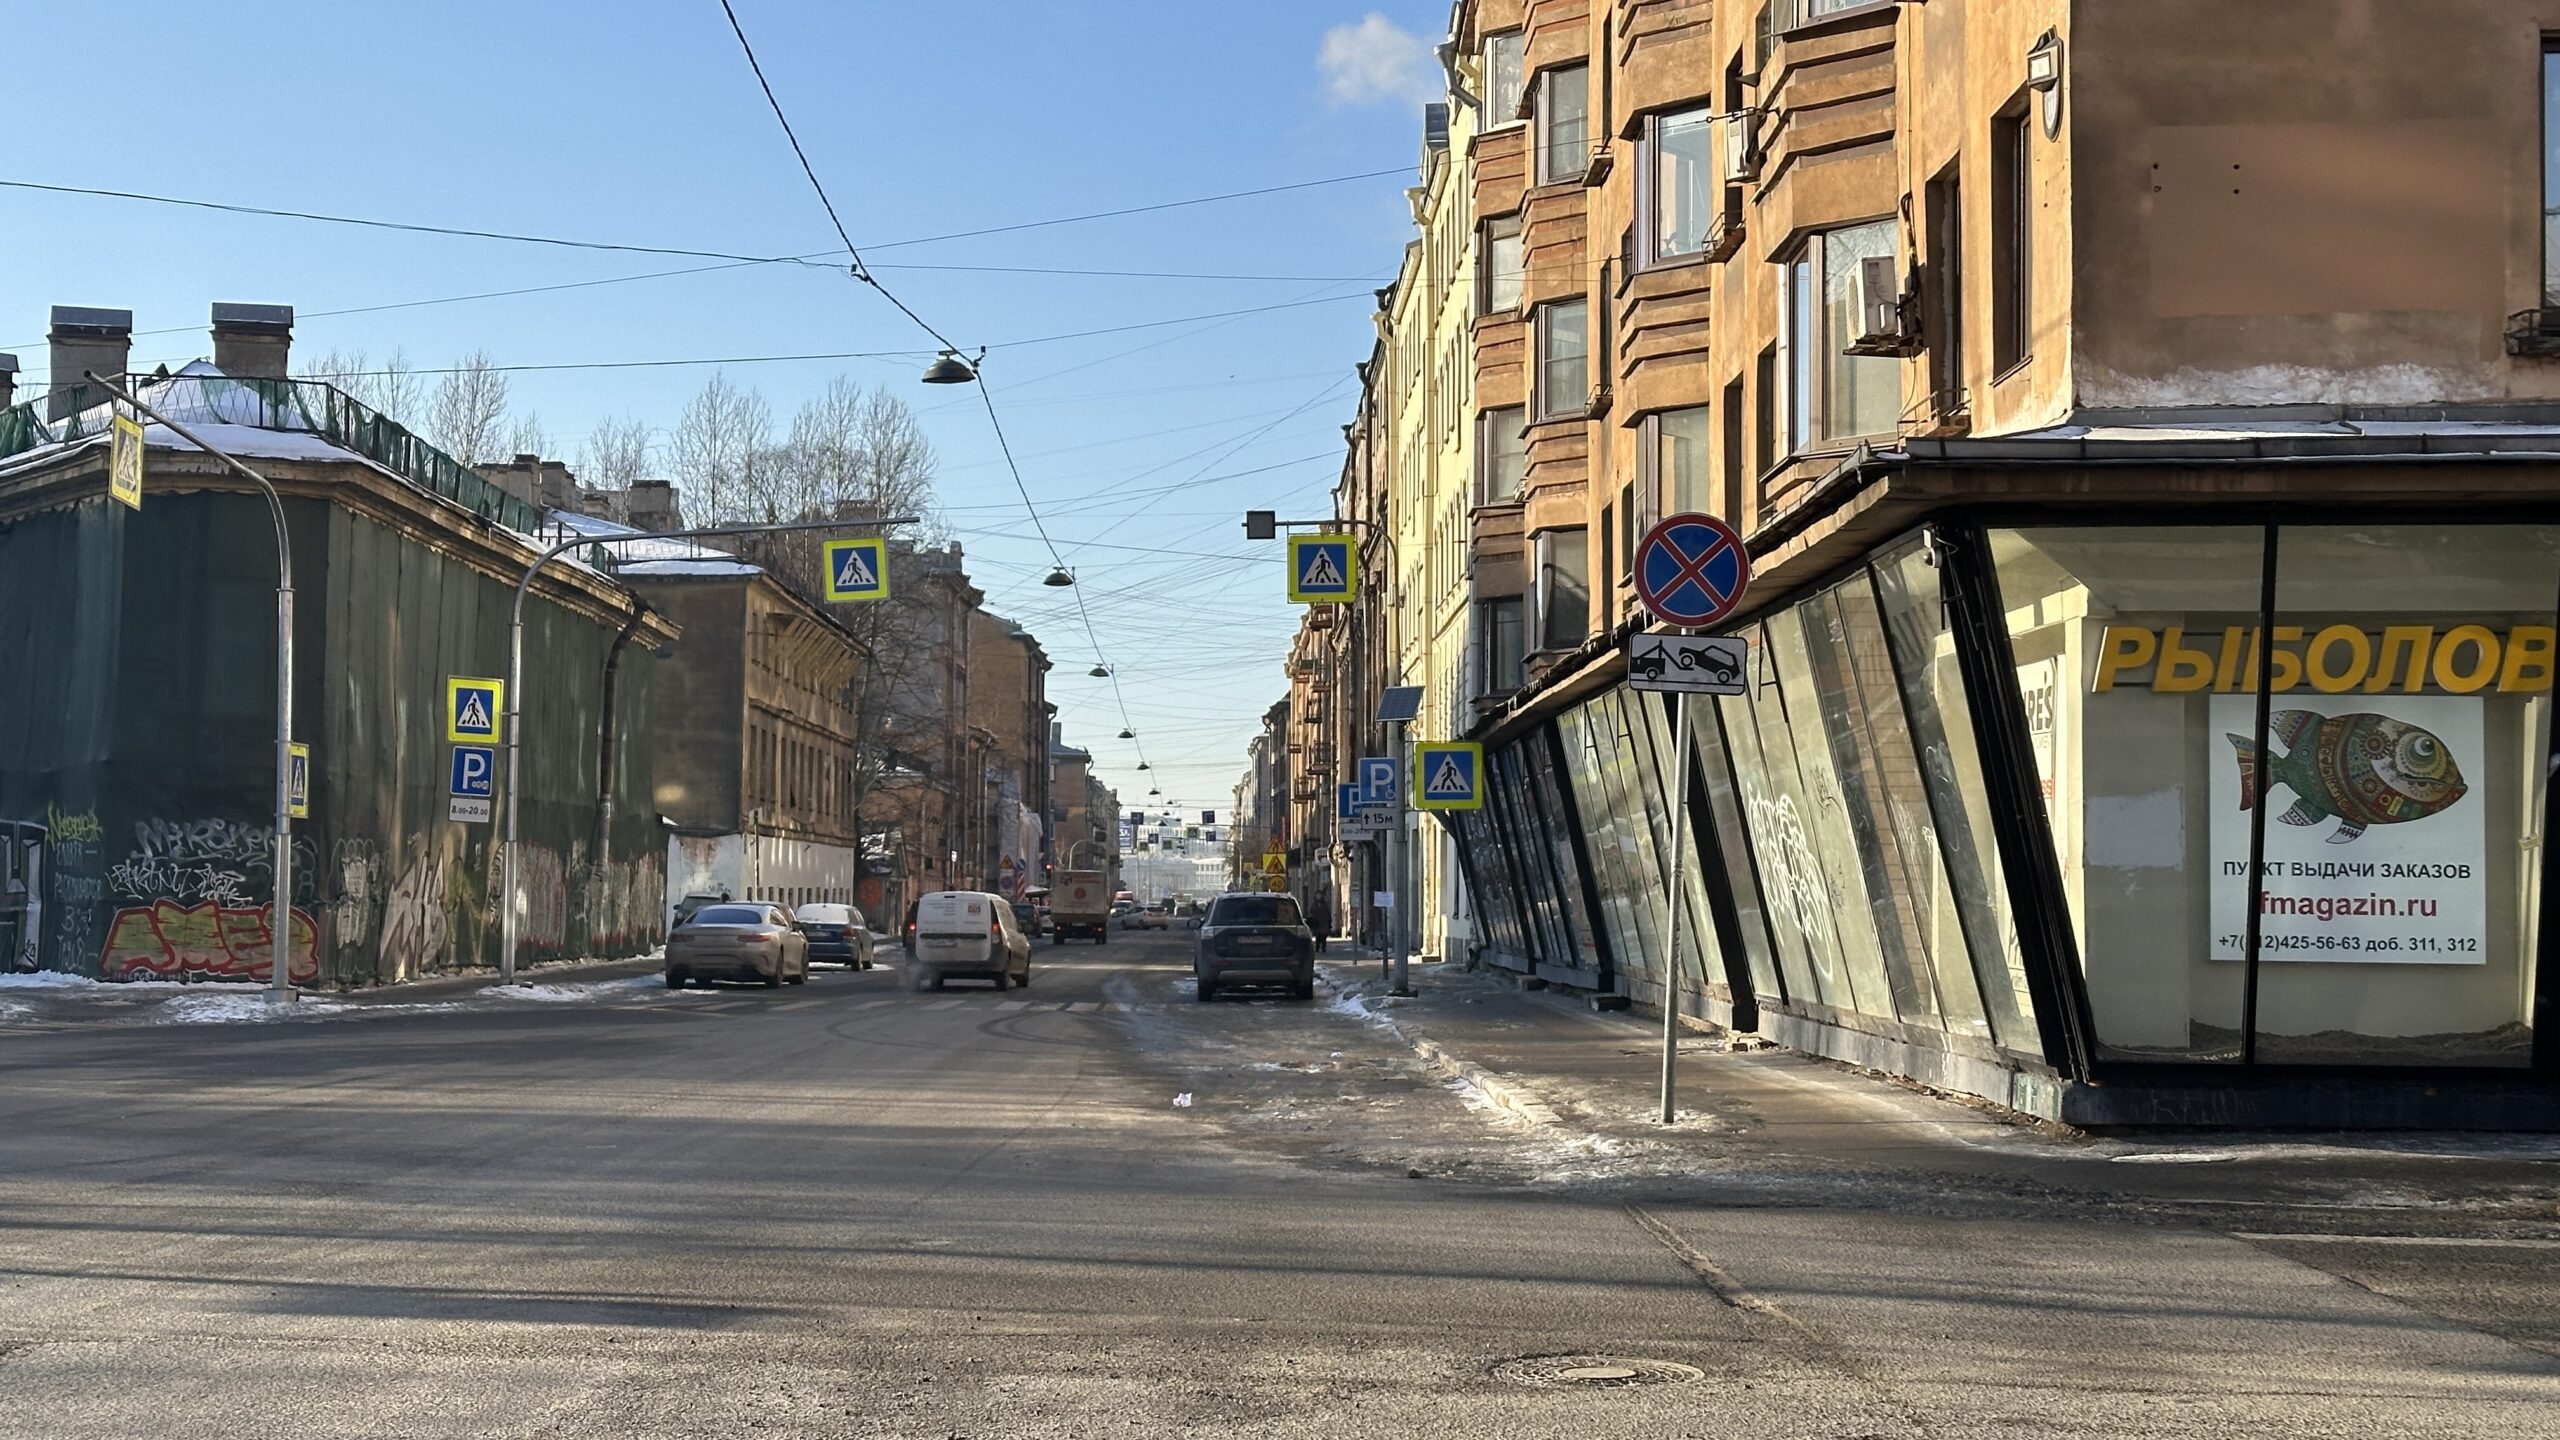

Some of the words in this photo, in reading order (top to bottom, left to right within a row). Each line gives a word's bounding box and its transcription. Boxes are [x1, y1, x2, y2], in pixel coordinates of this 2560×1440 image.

[2091, 624, 2556, 693] РЫБОЛОВ
[462, 753, 485, 789] P
[1370, 763, 1393, 797] P
[2223, 861, 2285, 876] ПУКТ
[2290, 861, 2375, 879] ВЫДАЧИ
[2380, 864, 2471, 879] ЗАКАЗОВ
[2365, 936, 2404, 951] доб.
[2408, 937, 2443, 953] 311,
[2447, 938, 2477, 951] 312
